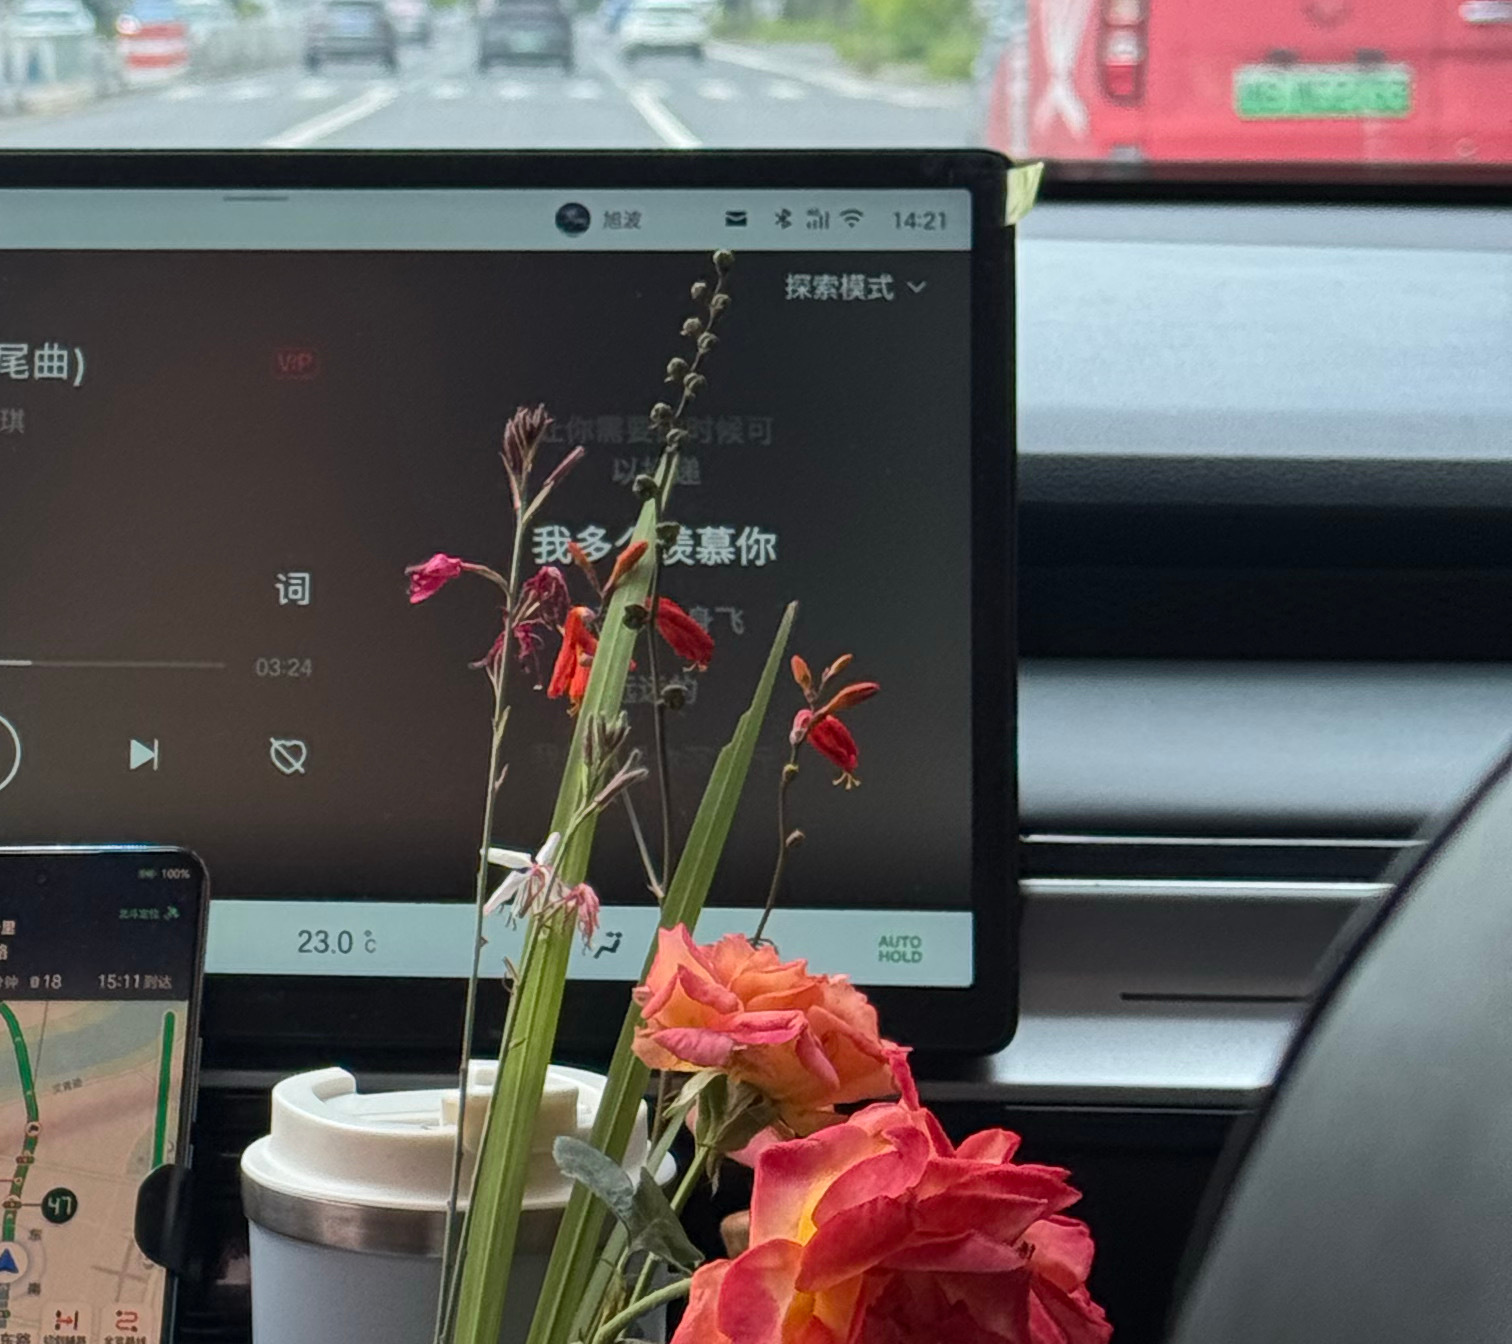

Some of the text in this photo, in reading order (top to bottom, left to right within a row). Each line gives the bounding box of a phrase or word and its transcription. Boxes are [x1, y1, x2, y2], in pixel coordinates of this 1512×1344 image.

[893, 209, 948, 232] 14:21
[785, 272, 895, 303] 探索模式
[532, 524, 777, 567] 我多羡慕你
[275, 572, 312, 606] 词
[255, 657, 313, 678] 03:24
[296, 929, 354, 956] 23.0
[877, 935, 922, 950] AUTO
[877, 950, 922, 965] HOLD
[43, 973, 62, 990] 18
[47, 1195, 72, 1216] 47
